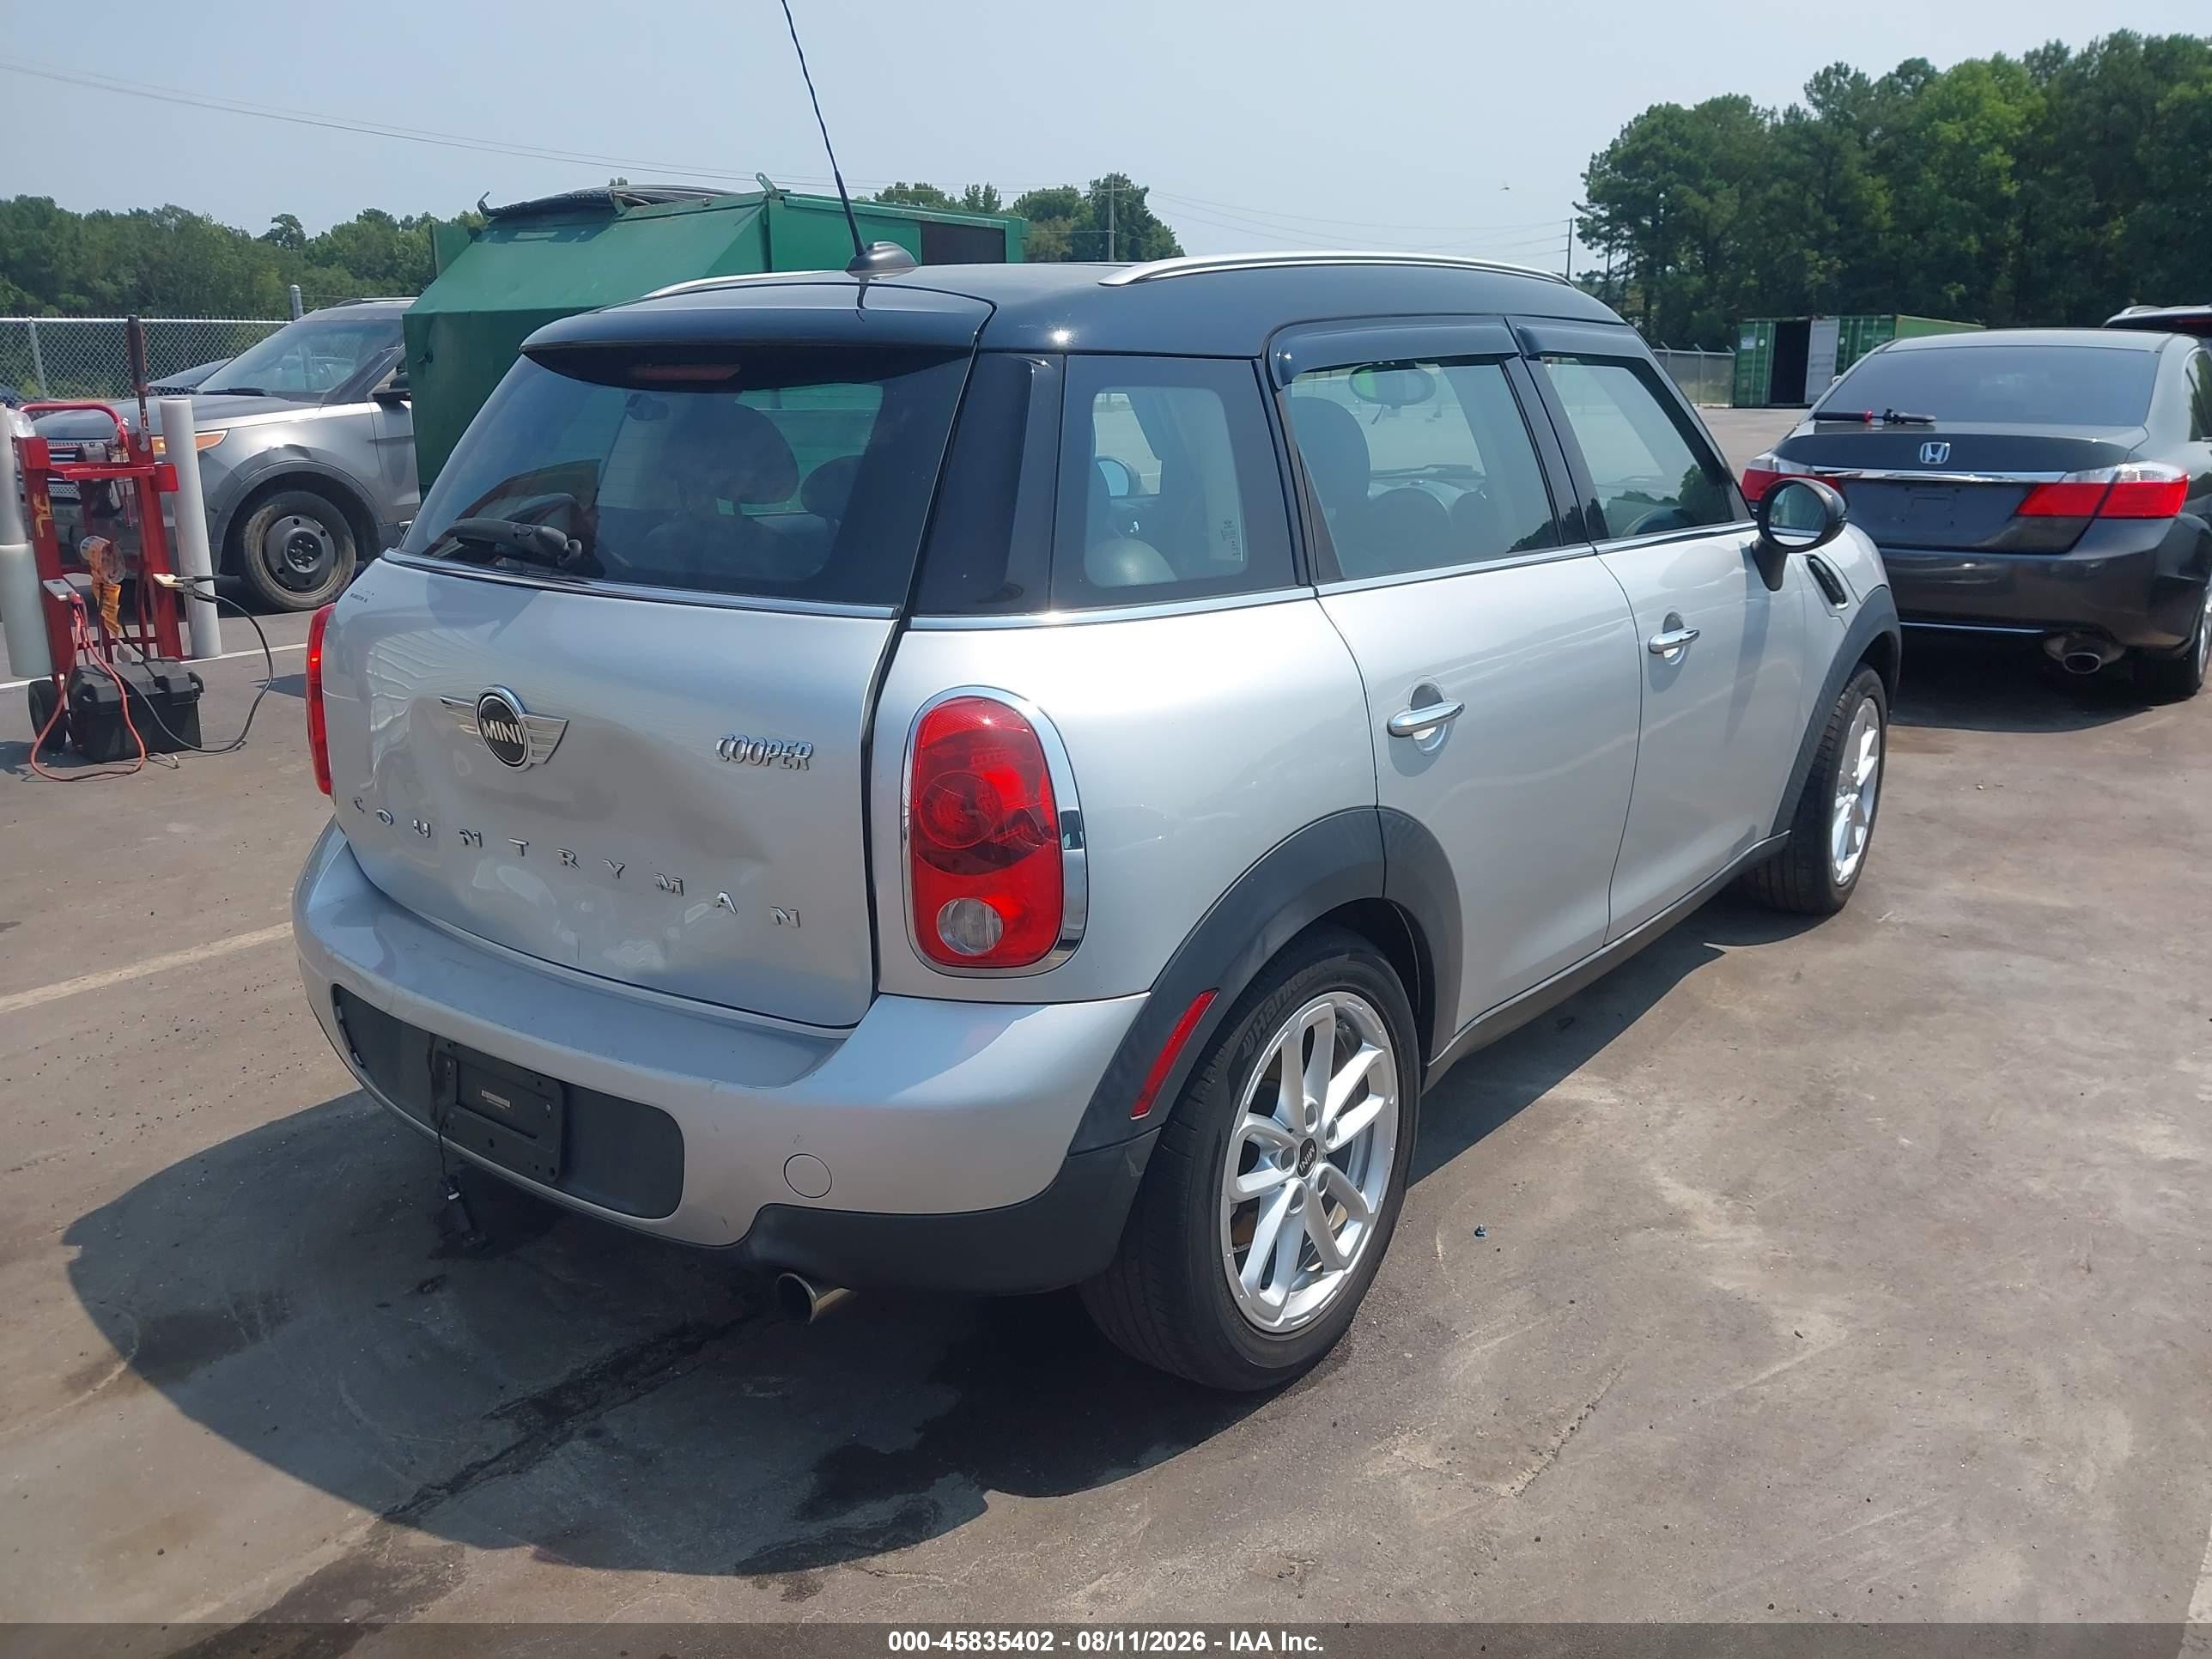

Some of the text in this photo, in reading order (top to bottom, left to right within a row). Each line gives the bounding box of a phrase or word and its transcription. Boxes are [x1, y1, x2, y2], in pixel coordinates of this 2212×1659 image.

[481, 718, 524, 744] MINI
[715, 734, 813, 770] COOPER
[353, 796, 801, 928] COUNTRYMAN
[1298, 1145, 1316, 1172] MINI
